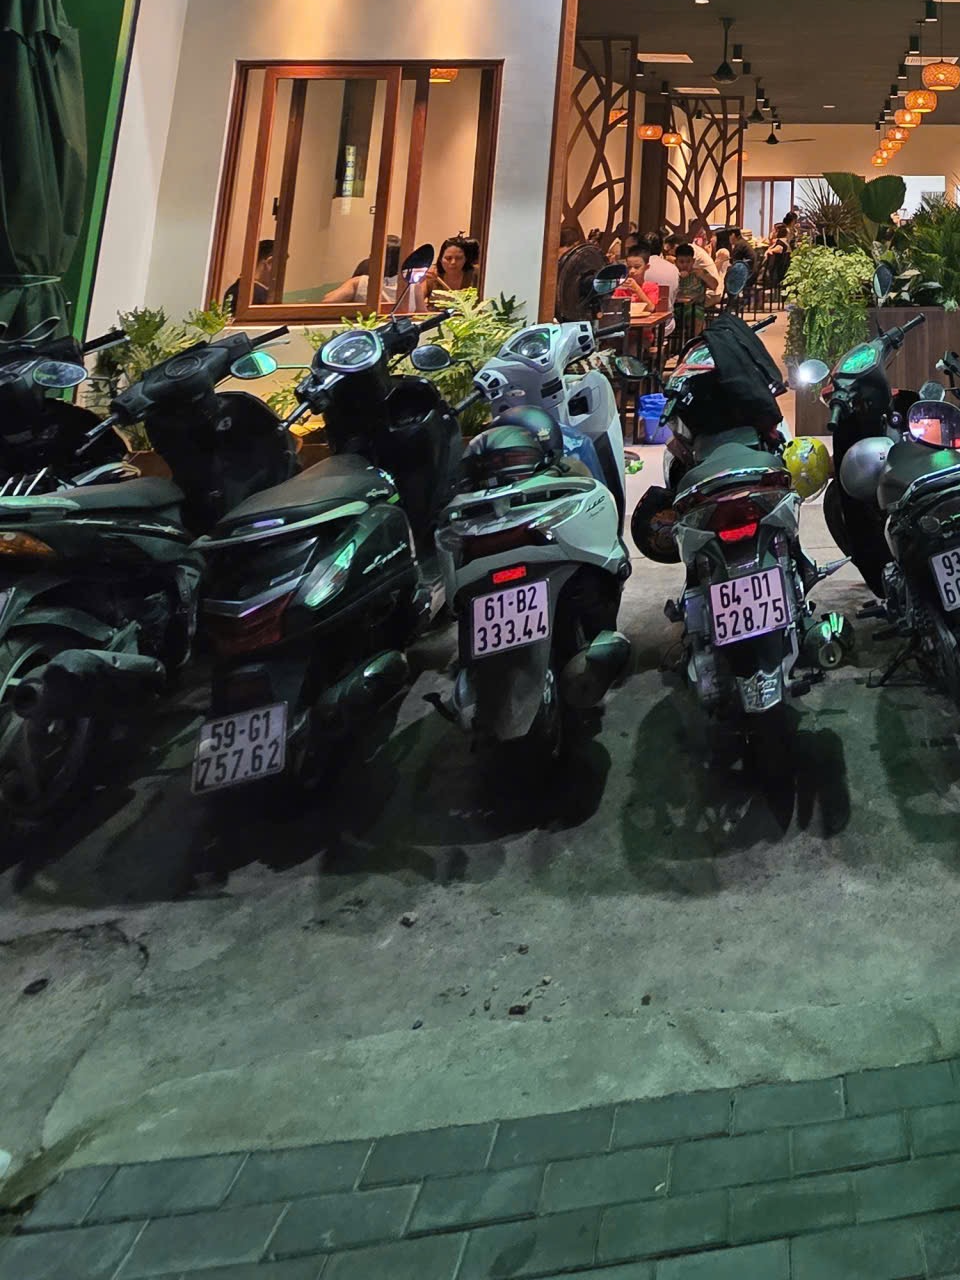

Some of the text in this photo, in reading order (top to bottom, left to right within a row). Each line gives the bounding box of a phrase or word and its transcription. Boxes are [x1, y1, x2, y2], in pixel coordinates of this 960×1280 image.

[484, 586, 538, 621] 61-B2
[719, 573, 771, 609] 64-D1
[477, 611, 547, 652] 333.44
[715, 598, 785, 639] 528.75
[210, 710, 271, 752] 59-G1
[199, 737, 281, 787] 757.62
